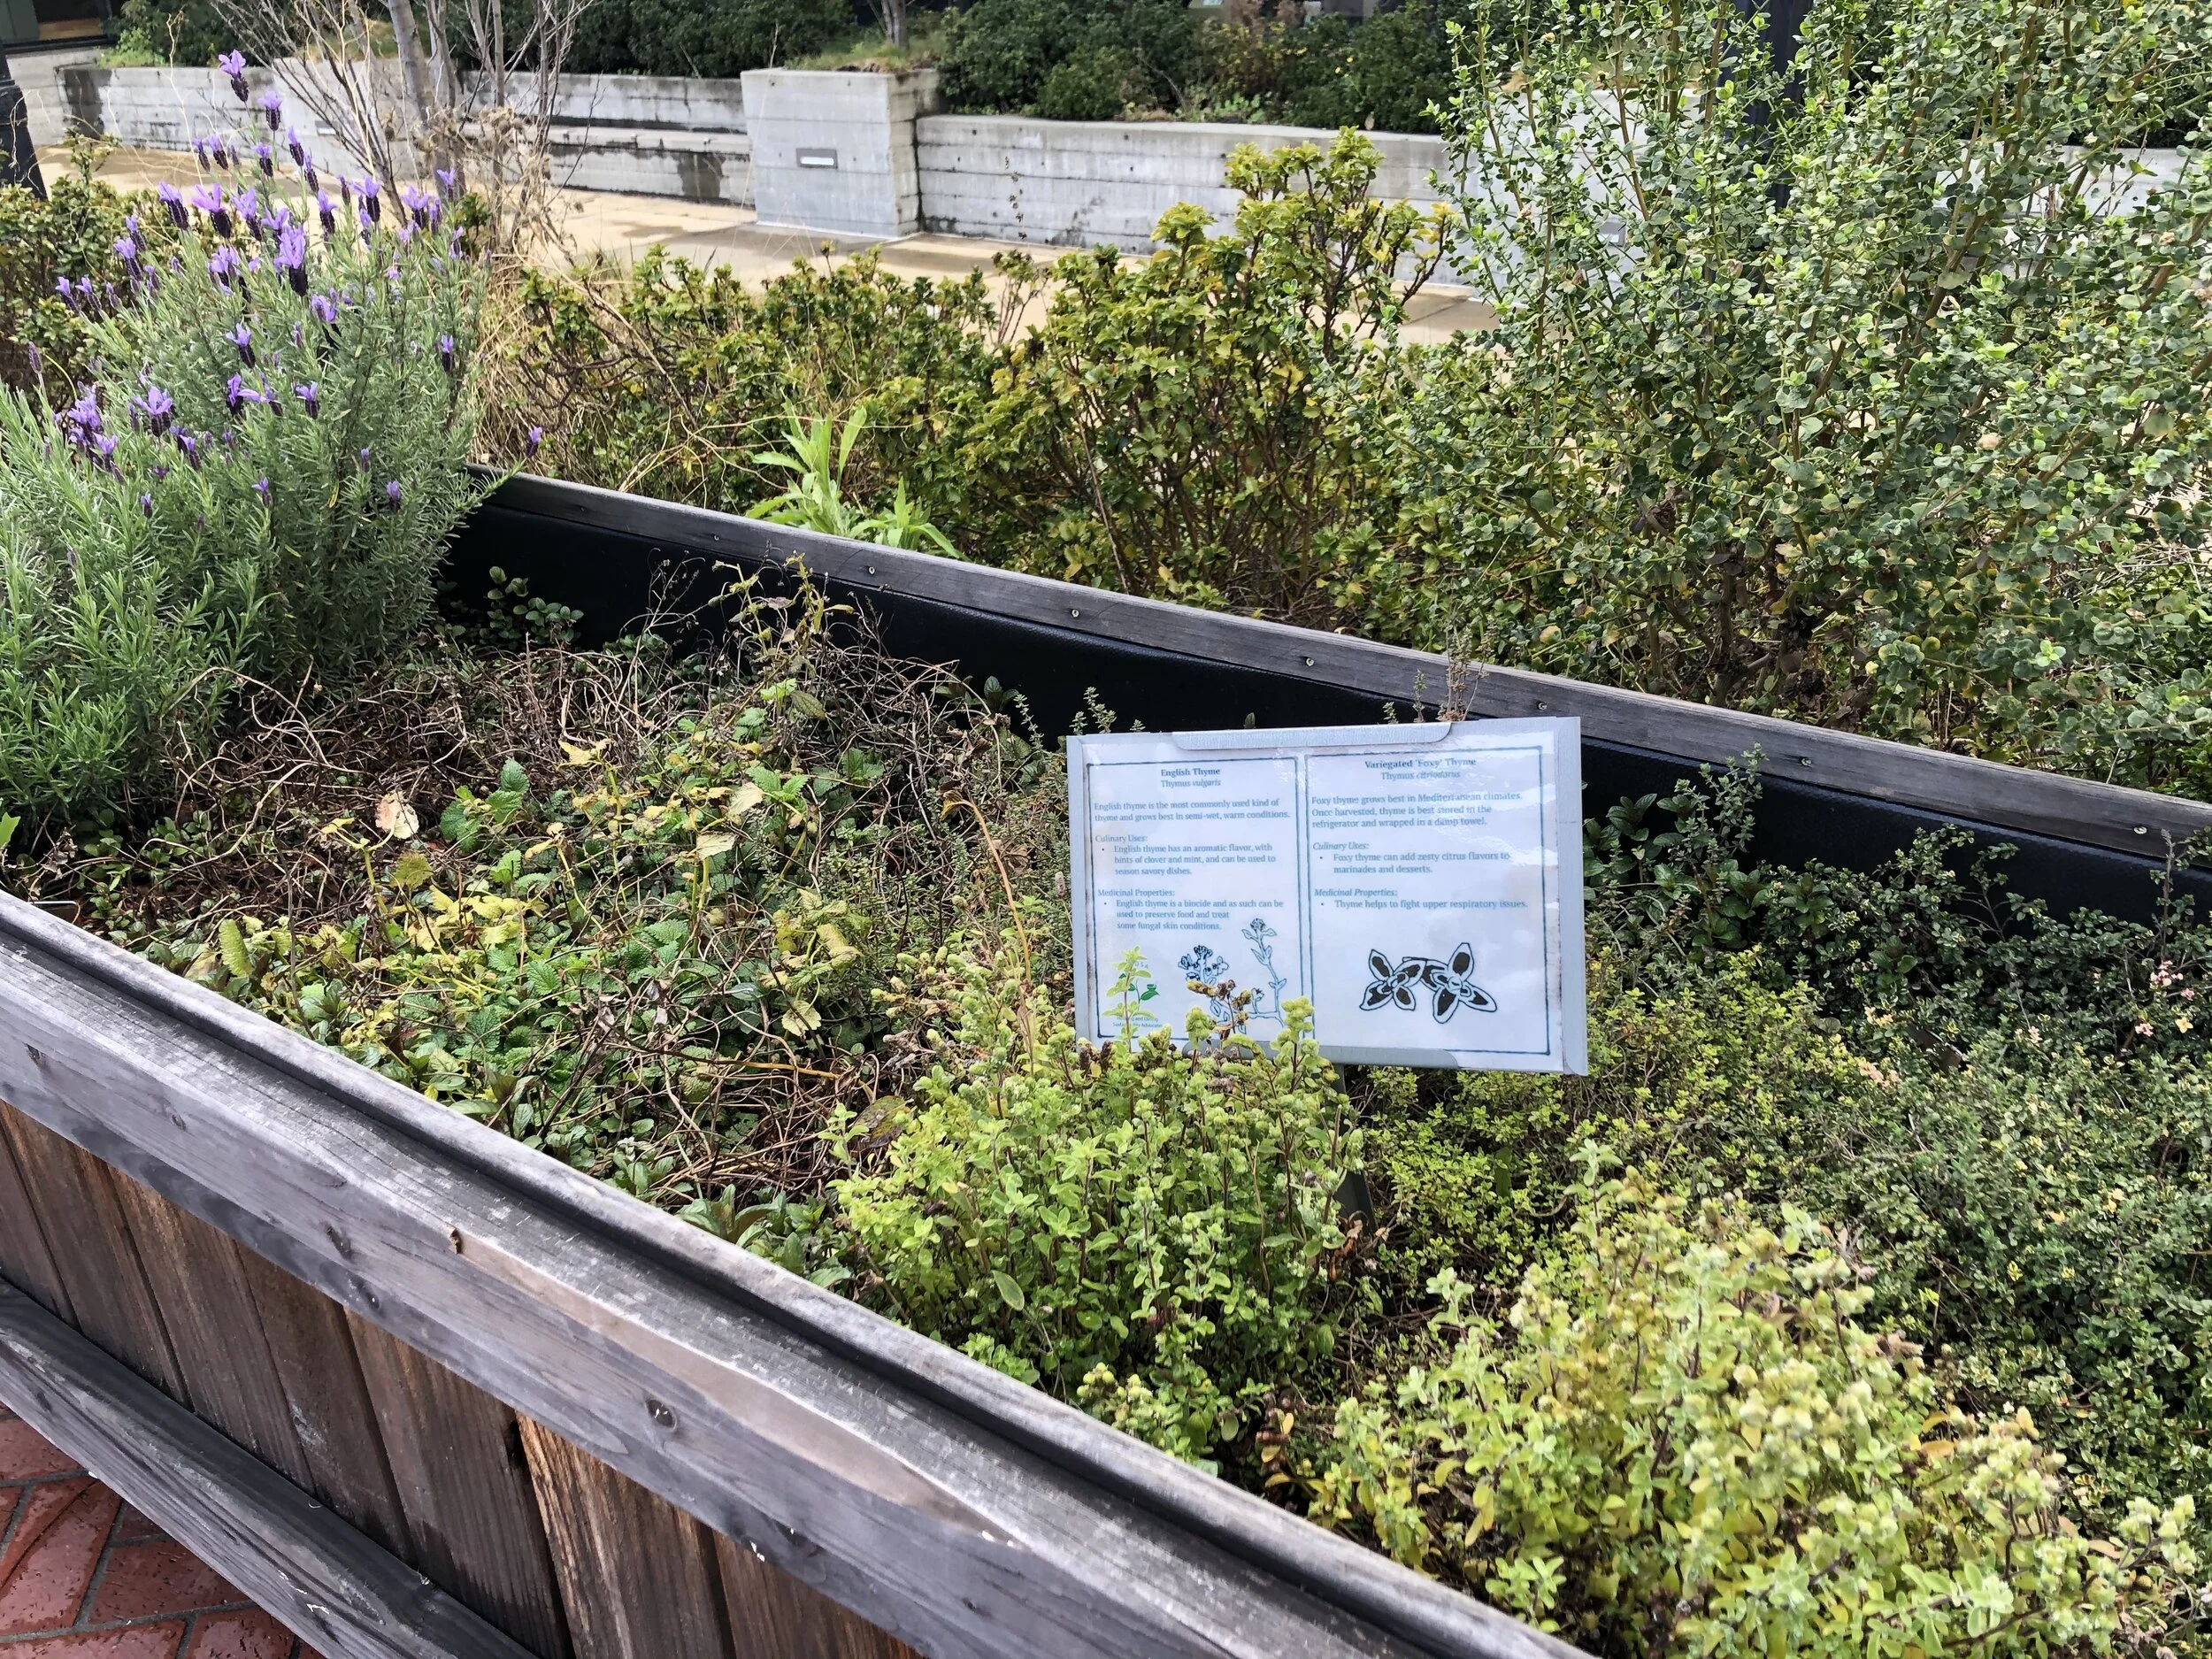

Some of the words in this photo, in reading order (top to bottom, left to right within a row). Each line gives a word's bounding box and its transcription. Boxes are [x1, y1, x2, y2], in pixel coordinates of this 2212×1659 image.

[1364, 759, 1413, 770] Variegated
[1444, 757, 1477, 769] Thyme
[1161, 768, 1191, 779] English
[1192, 768, 1220, 777] Thyme
[1381, 771, 1415, 782] Thymus
[1161, 780, 1191, 789] Thymus
[1192, 778, 1221, 788] vulgaris
[1311, 796, 1331, 806] Foxy
[1333, 795, 1359, 805] thyme
[1361, 796, 1386, 805] grows
[1387, 795, 1406, 803] best
[1417, 792, 1481, 802] Mediterranean
[1484, 791, 1522, 800] climates.
[1094, 802, 1122, 811] English
[1124, 802, 1147, 811] thyme
[1190, 800, 1231, 809] commonly
[1252, 798, 1269, 807] kind
[1271, 798, 1280, 807] of
[1334, 807, 1378, 816] harvested,
[1379, 807, 1406, 817] thyme
[1417, 805, 1435, 815] best
[1437, 805, 1464, 814] stored
[1466, 805, 1476, 815] in
[1312, 819, 1359, 830] refrigerator
[1361, 818, 1377, 827] and
[1379, 818, 1415, 828] wrapped
[1417, 818, 1426, 826] in
[1434, 818, 1459, 827] damp
[1460, 817, 1486, 826] towel.
[1095, 835, 1126, 844] Culinary
[1114, 844, 1141, 854] English
[1143, 845, 1166, 854] thyme
[1228, 843, 1254, 852] flavor,
[1312, 842, 1347, 851] Culinary
[1333, 853, 1353, 863] Foxy
[1355, 853, 1382, 863] thyme
[1401, 852, 1416, 861] add
[1417, 854, 1440, 863] zesty
[1469, 851, 1499, 860] flavors
[1501, 852, 1510, 862] to
[1379, 864, 1394, 873] and
[1396, 864, 1432, 873] desserts.
[1098, 888, 1133, 897] Medicinal
[1135, 888, 1175, 898] Properties:
[1354, 888, 1398, 899] Properties:
[1117, 899, 1143, 909] English
[1145, 900, 1168, 909] thyme
[1184, 899, 1212, 908] biocide
[1239, 899, 1256, 908] such
[1274, 899, 1284, 908] be
[1334, 900, 1363, 910] Thyme
[1364, 899, 1387, 910] helps
[1400, 900, 1420, 910] fight
[1449, 900, 1497, 910] respiratory
[1211, 911, 1230, 920] treat
[1138, 921, 1161, 931] fungal
